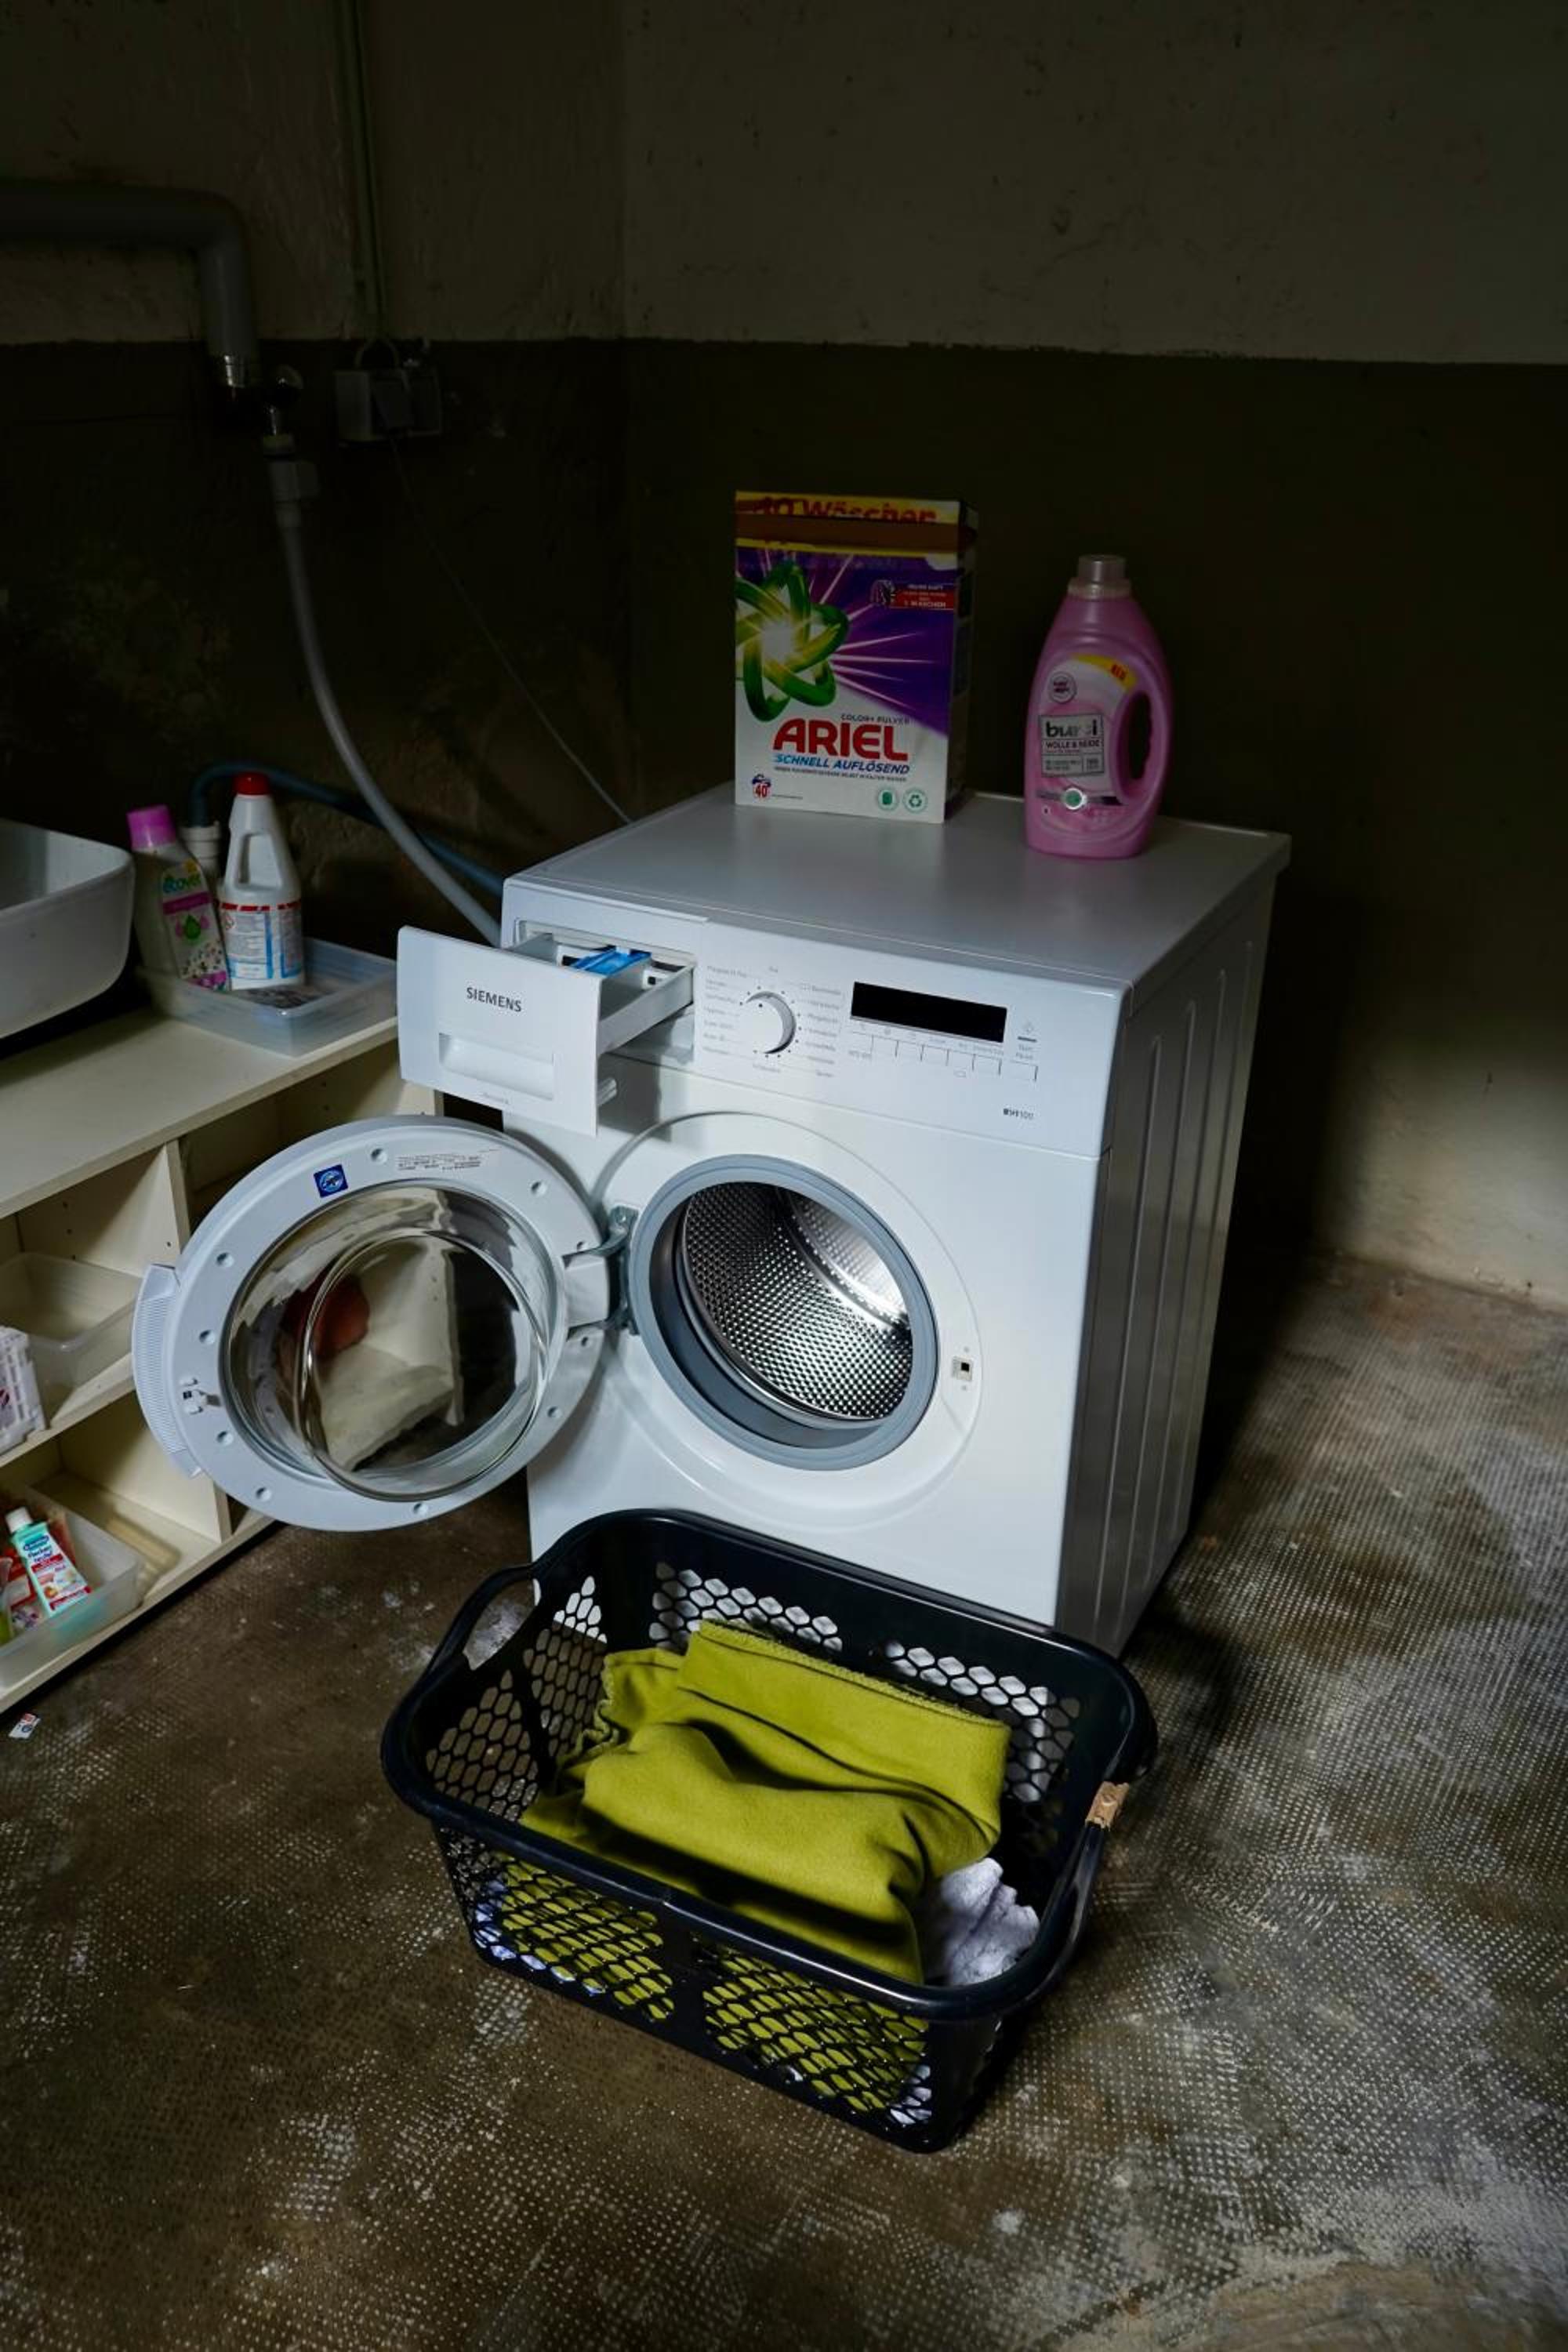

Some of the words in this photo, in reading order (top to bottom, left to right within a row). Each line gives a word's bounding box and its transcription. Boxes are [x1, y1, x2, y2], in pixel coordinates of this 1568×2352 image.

[773, 718, 908, 761] ARIEL
[776, 754, 829, 768] SCHNELL
[833, 760, 910, 775] AUFLÖSEND
[466, 987, 521, 1012] SIEMENS
